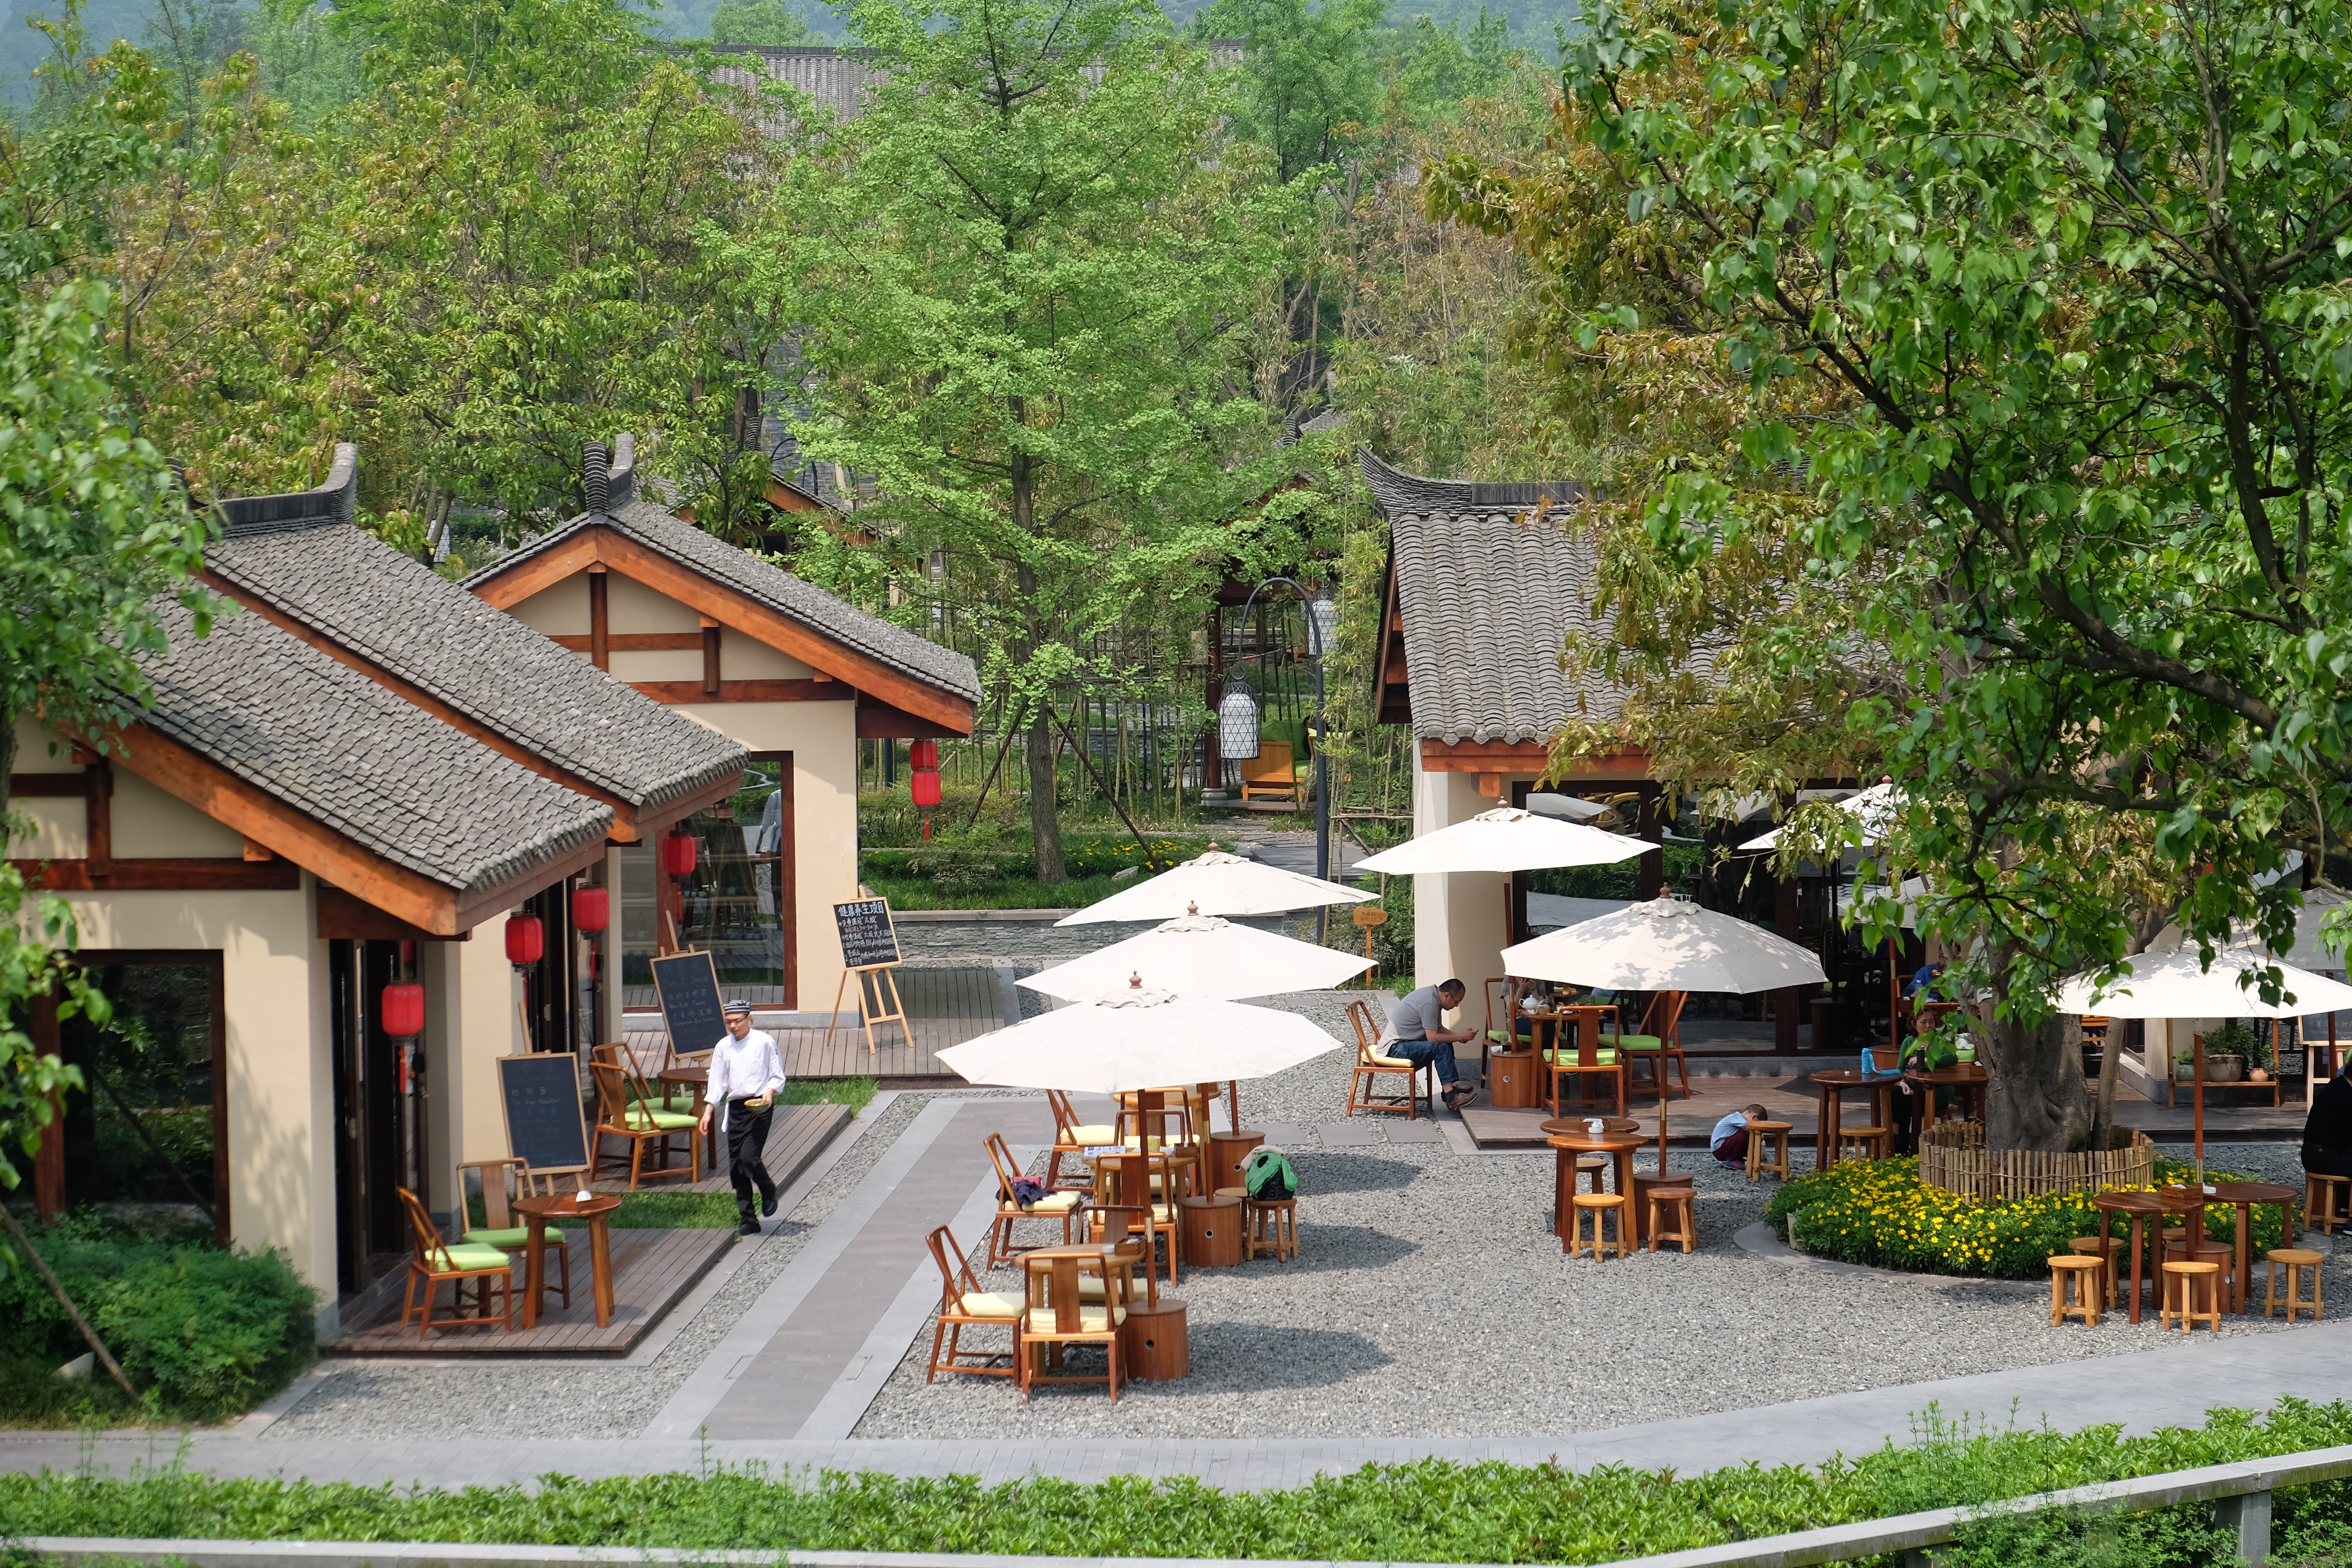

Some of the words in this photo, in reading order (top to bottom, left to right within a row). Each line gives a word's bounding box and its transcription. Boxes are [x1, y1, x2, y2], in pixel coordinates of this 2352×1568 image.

[838, 901, 884, 917] 健康养生项目
